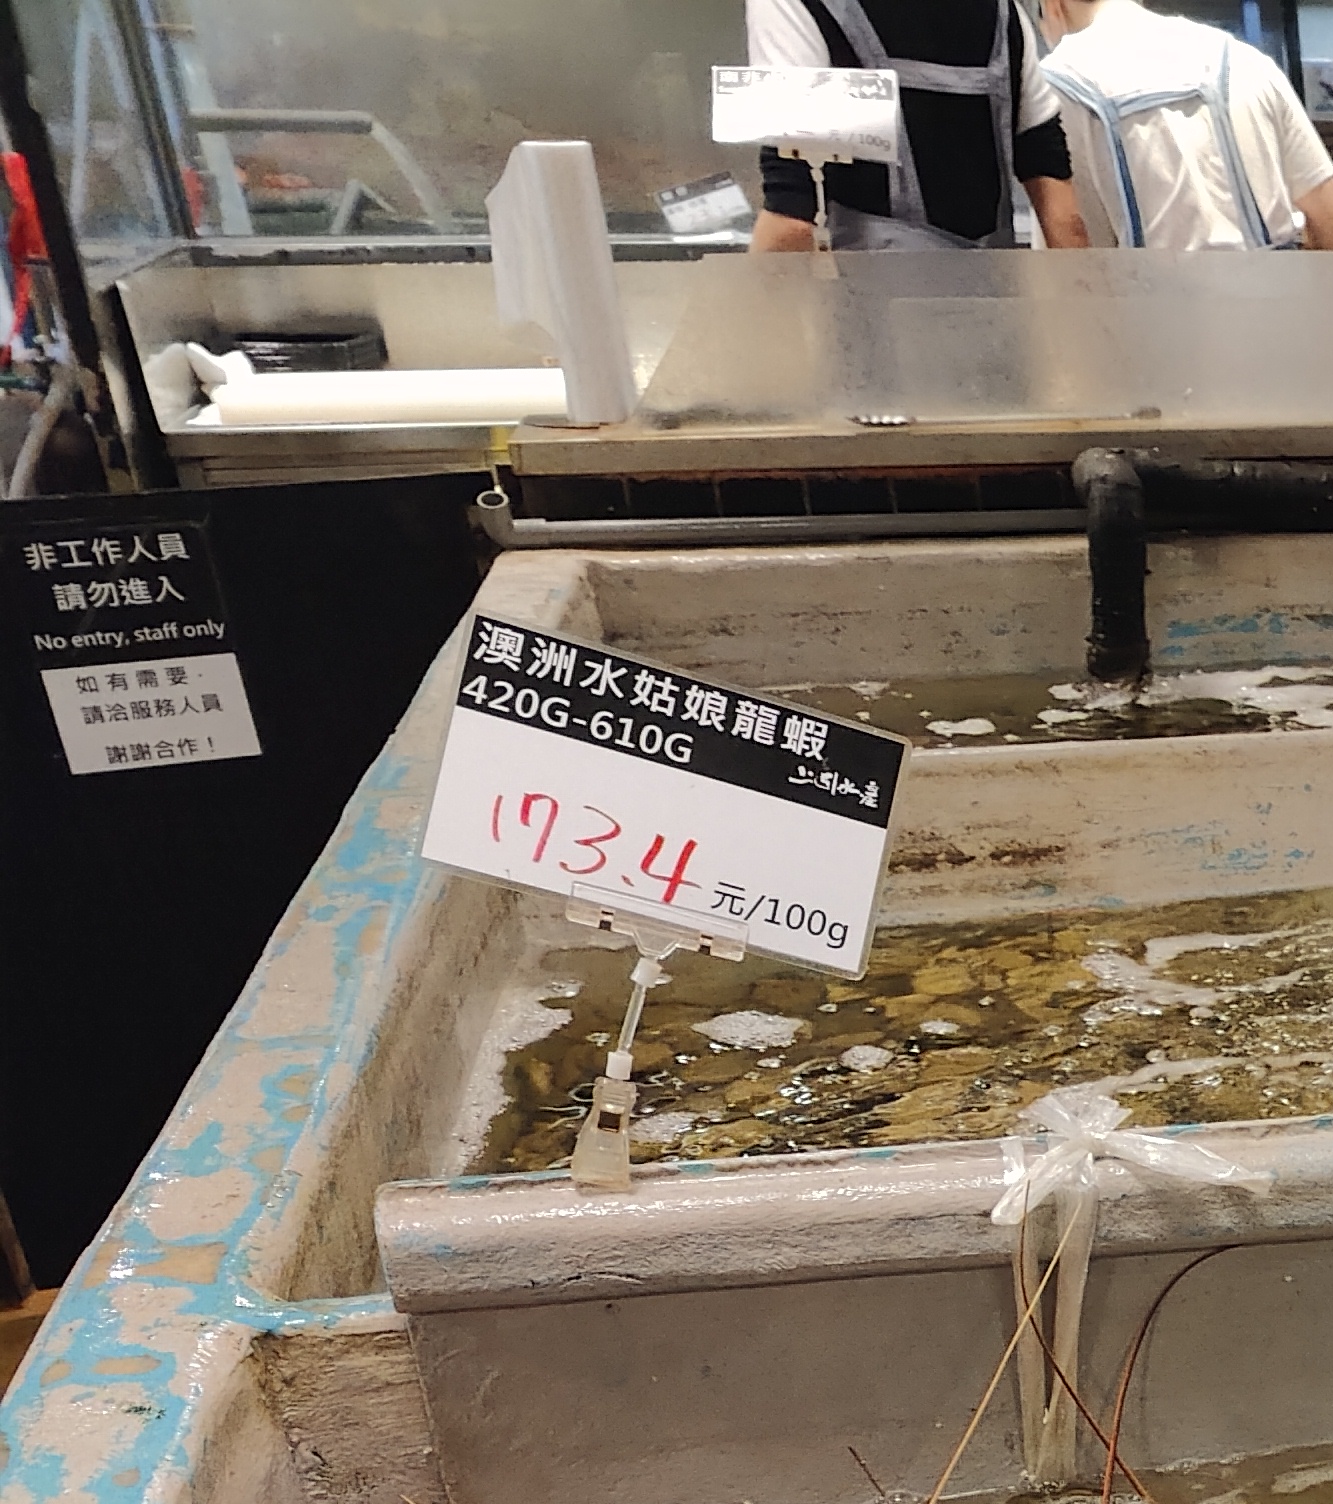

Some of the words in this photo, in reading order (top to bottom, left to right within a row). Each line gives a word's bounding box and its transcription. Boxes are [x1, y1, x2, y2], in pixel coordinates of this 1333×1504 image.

[23, 533, 190, 571] 非工作人員
[52, 576, 185, 612] 請勿進入
[34, 634, 66, 651] No
[71, 630, 130, 650] entry,
[135, 622, 178, 643] staff
[184, 619, 226, 640] only
[81, 692, 225, 726] 請洽服務人員
[472, 620, 829, 762] 澳洲水姑娘龍蝦
[461, 674, 695, 765] 420G-610G
[490, 791, 703, 905] 173.4
